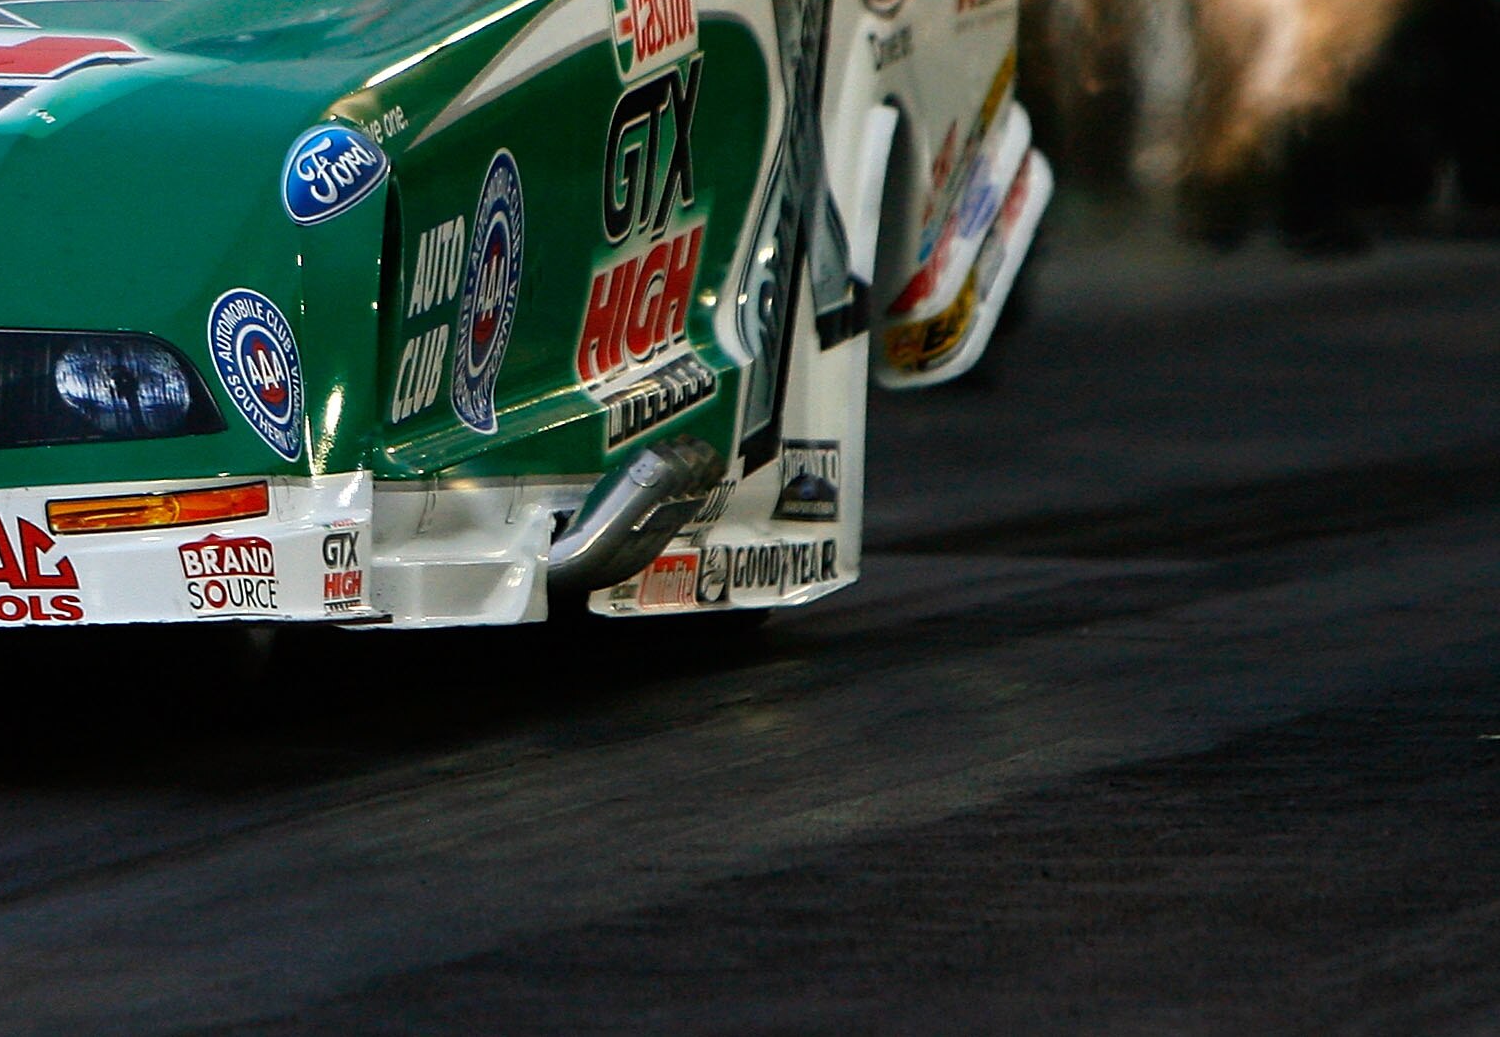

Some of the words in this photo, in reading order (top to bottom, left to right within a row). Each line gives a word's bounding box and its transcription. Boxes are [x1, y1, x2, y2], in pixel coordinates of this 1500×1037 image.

[297, 135, 379, 205] Ford
[603, 52, 704, 246] GTX
[408, 215, 465, 319] AUTO
[476, 254, 506, 322] AAA
[216, 298, 265, 363] AUTOMOBILE
[266, 311, 293, 352] CLUB
[576, 224, 705, 382] HIGH
[246, 349, 286, 391] AAA
[392, 324, 450, 424] CLUB
[182, 545, 274, 577] BRAND
[322, 531, 360, 569] GTX
[188, 578, 278, 609] SOURCE
[324, 570, 363, 598] HIGH
